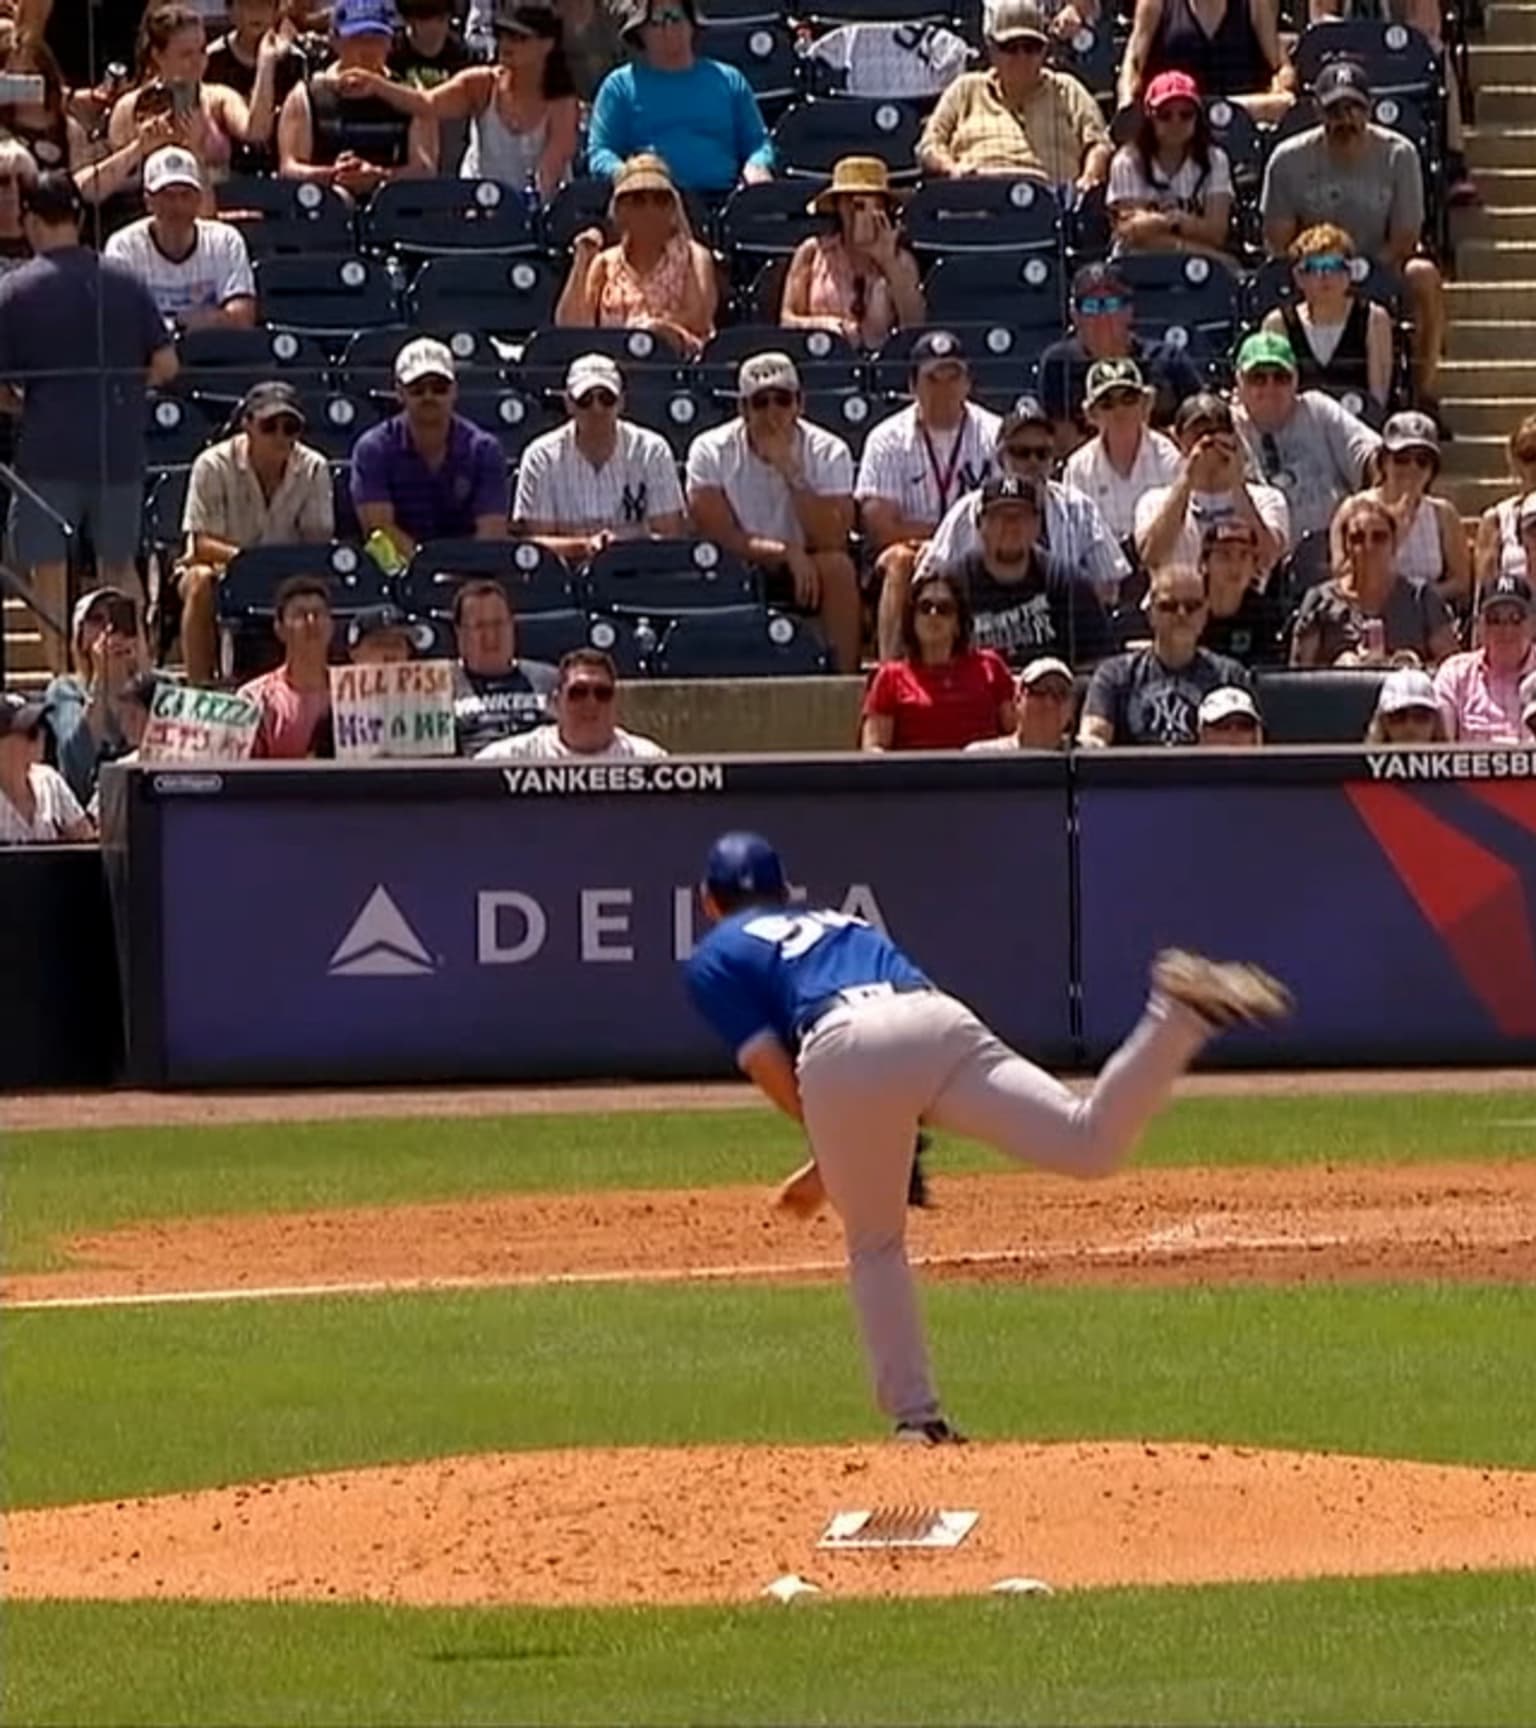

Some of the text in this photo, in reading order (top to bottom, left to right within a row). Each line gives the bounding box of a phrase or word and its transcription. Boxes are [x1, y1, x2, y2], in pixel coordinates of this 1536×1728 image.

[337, 666, 388, 701] ALL
[503, 765, 724, 792] YANKEES.COM
[477, 885, 894, 963] DELA
